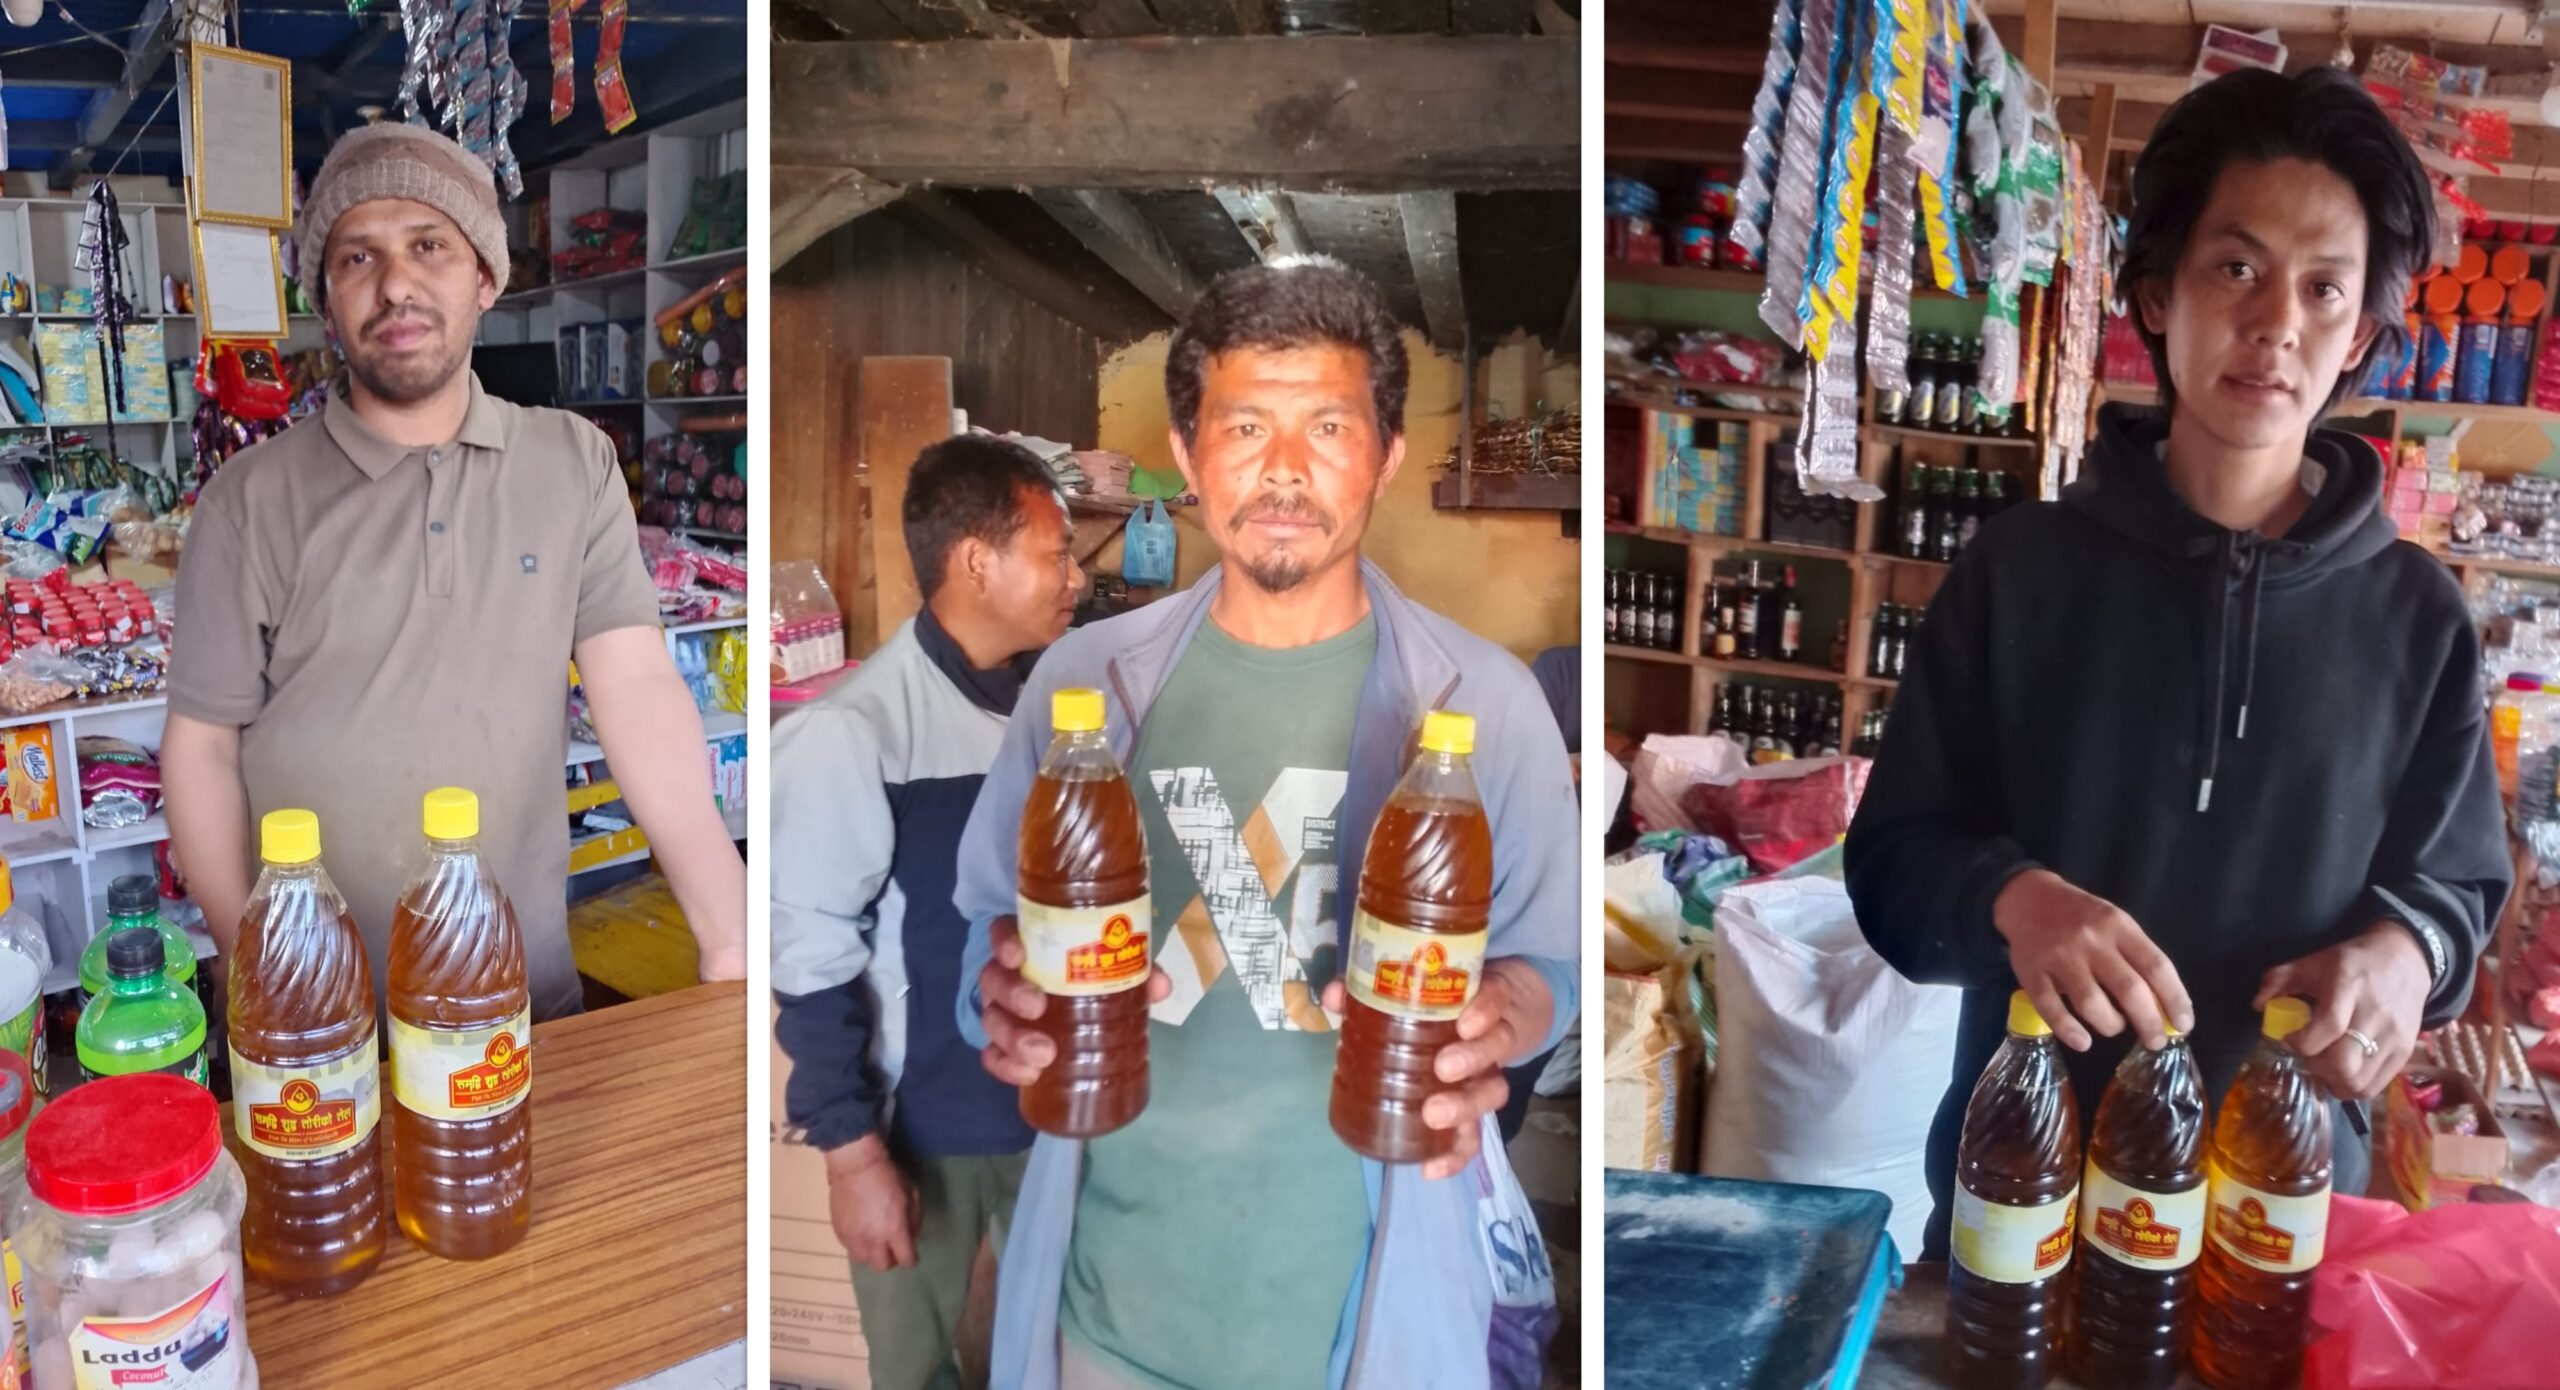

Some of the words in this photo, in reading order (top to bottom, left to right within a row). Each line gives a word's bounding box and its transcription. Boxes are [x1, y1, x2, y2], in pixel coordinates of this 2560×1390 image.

[1303, 818, 1337, 831] DISTRICT
[82, 1338, 182, 1365] Laddu
[122, 1367, 166, 1382] Coconut
